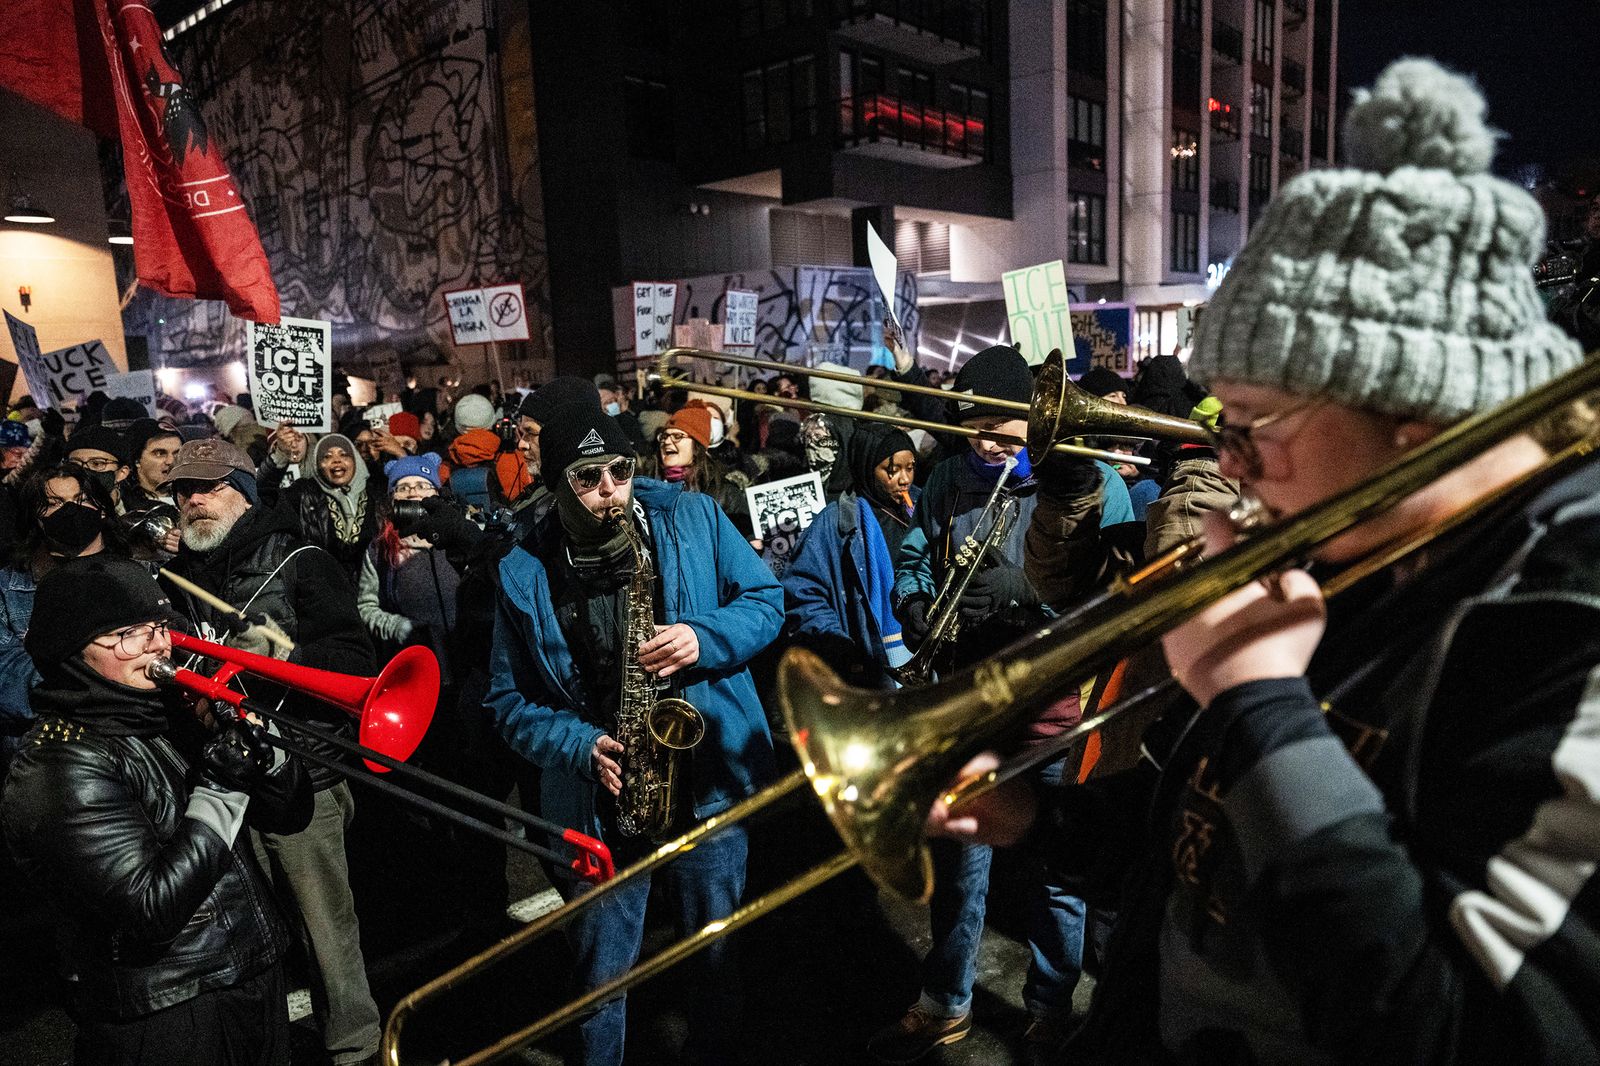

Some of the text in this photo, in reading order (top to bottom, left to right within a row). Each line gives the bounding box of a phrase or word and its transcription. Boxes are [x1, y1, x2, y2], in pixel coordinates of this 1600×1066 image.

[1004, 262, 1066, 316] ICE
[452, 320, 488, 334] MIGRA
[459, 307, 474, 318] LA
[1012, 309, 1069, 363] OUT
[44, 342, 105, 375] UCK
[263, 347, 315, 375] ICE
[48, 367, 108, 402] ICE
[261, 372, 318, 396] OUT
[766, 506, 814, 536] ICE
